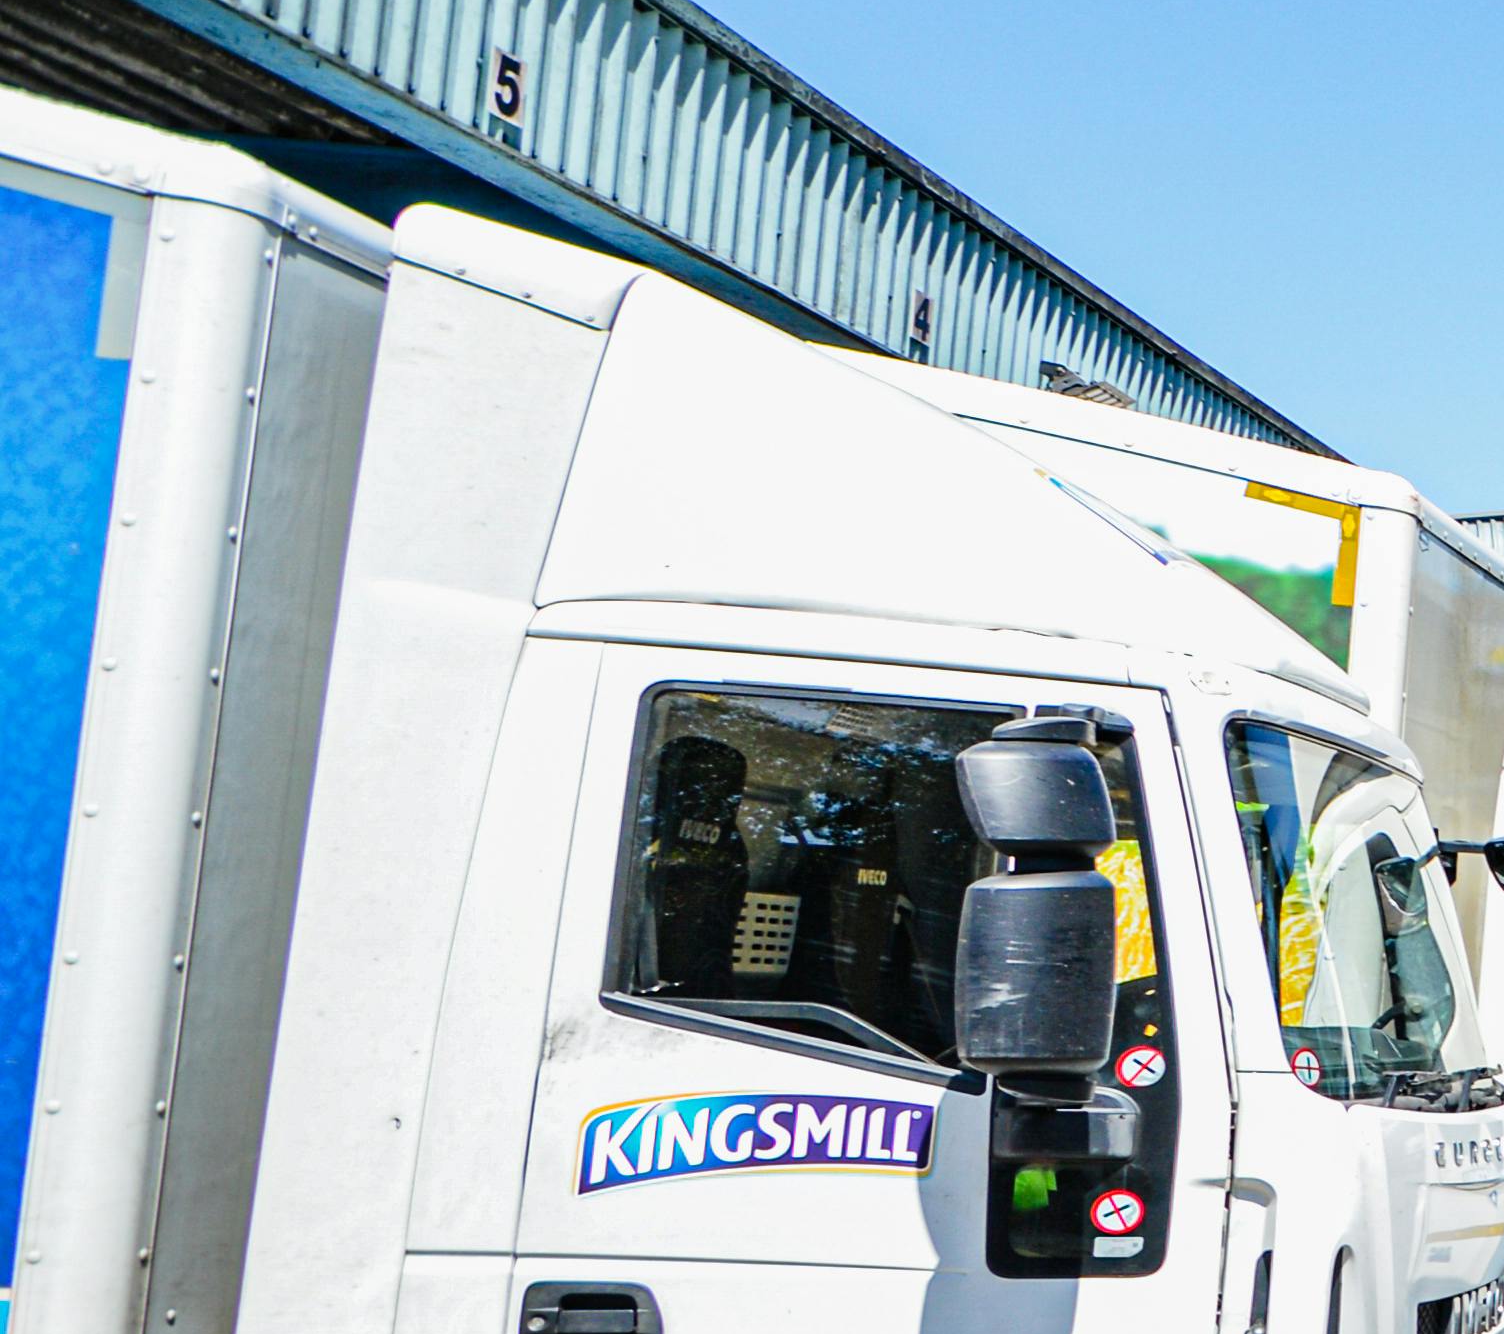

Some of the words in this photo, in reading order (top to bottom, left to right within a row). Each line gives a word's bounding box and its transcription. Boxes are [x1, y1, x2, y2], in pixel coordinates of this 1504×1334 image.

[494, 53, 521, 118] 5
[914, 298, 930, 341] 4
[857, 868, 888, 886] IVECO
[589, 1101, 919, 1185] KINGSMILL
